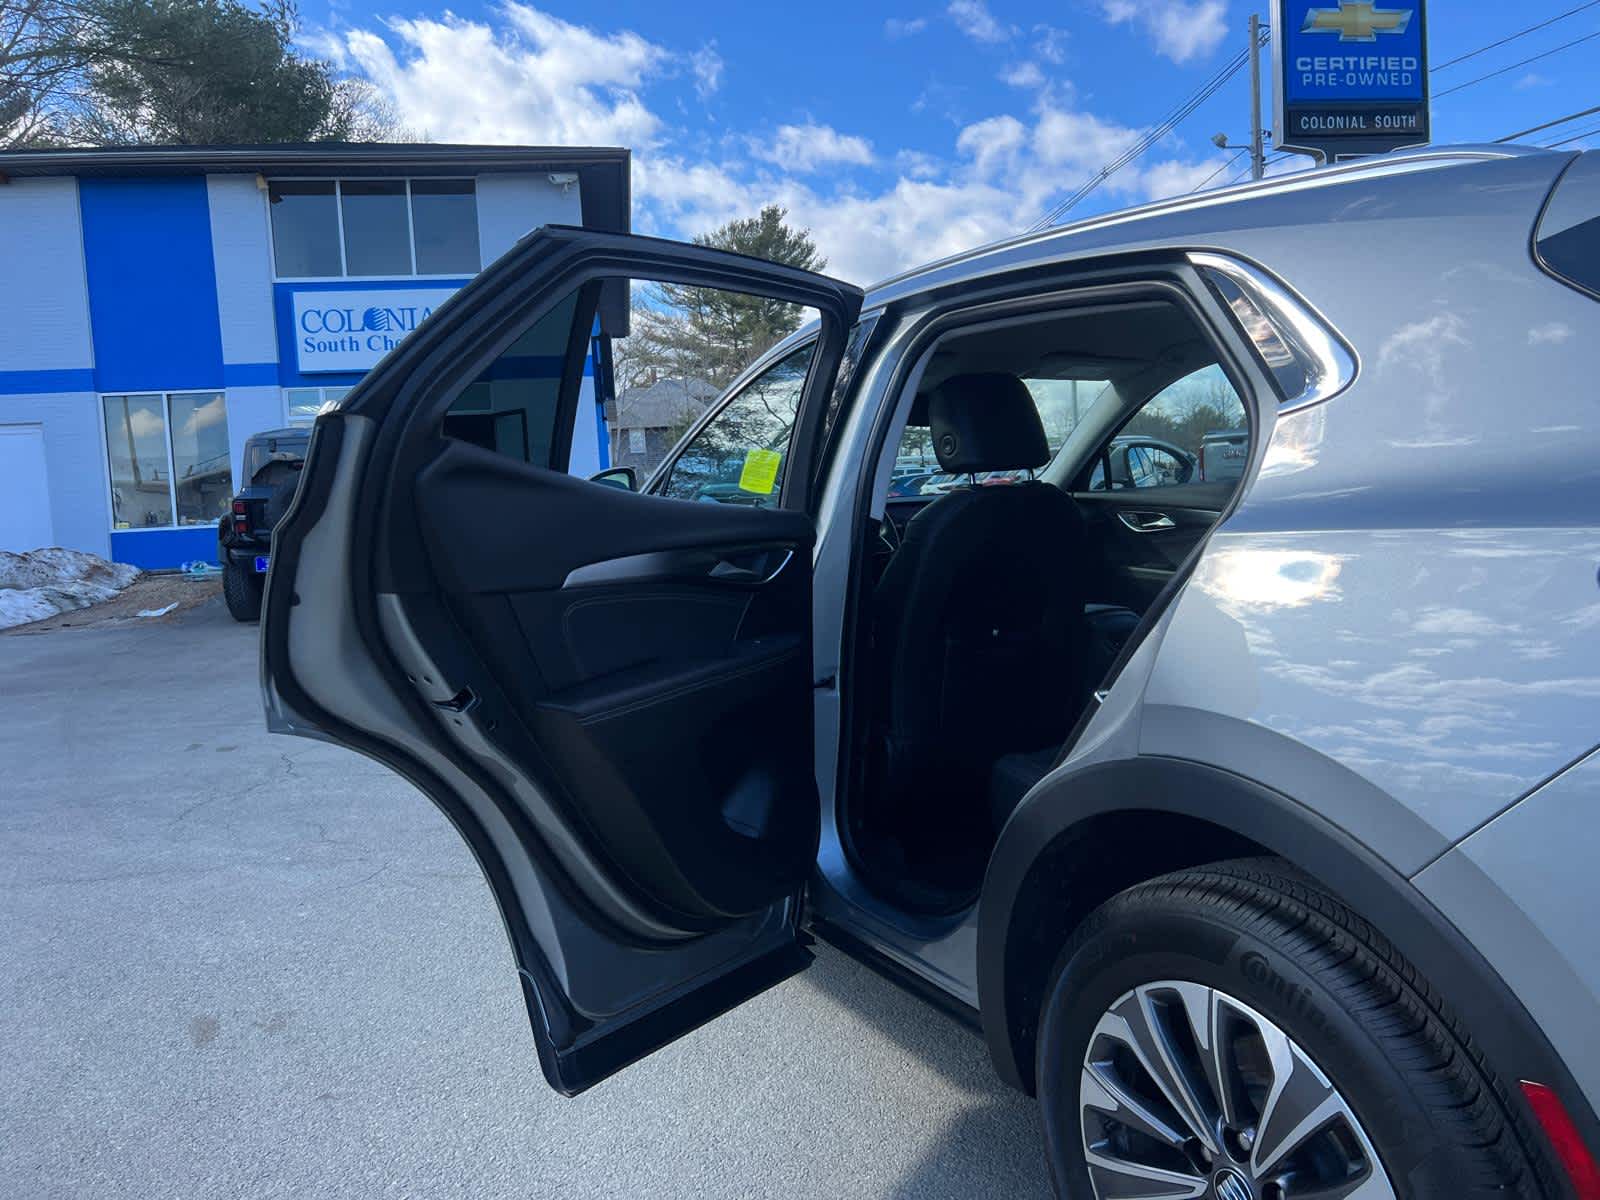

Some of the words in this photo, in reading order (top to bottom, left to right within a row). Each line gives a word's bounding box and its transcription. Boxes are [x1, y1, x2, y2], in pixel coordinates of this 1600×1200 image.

[1296, 57, 1417, 71] CERTIFIED
[1303, 72, 1412, 86] PRE-OWNED
[1301, 115, 1366, 129] COLONIAL
[1375, 115, 1416, 128] SOUTH
[304, 336, 360, 353] South
